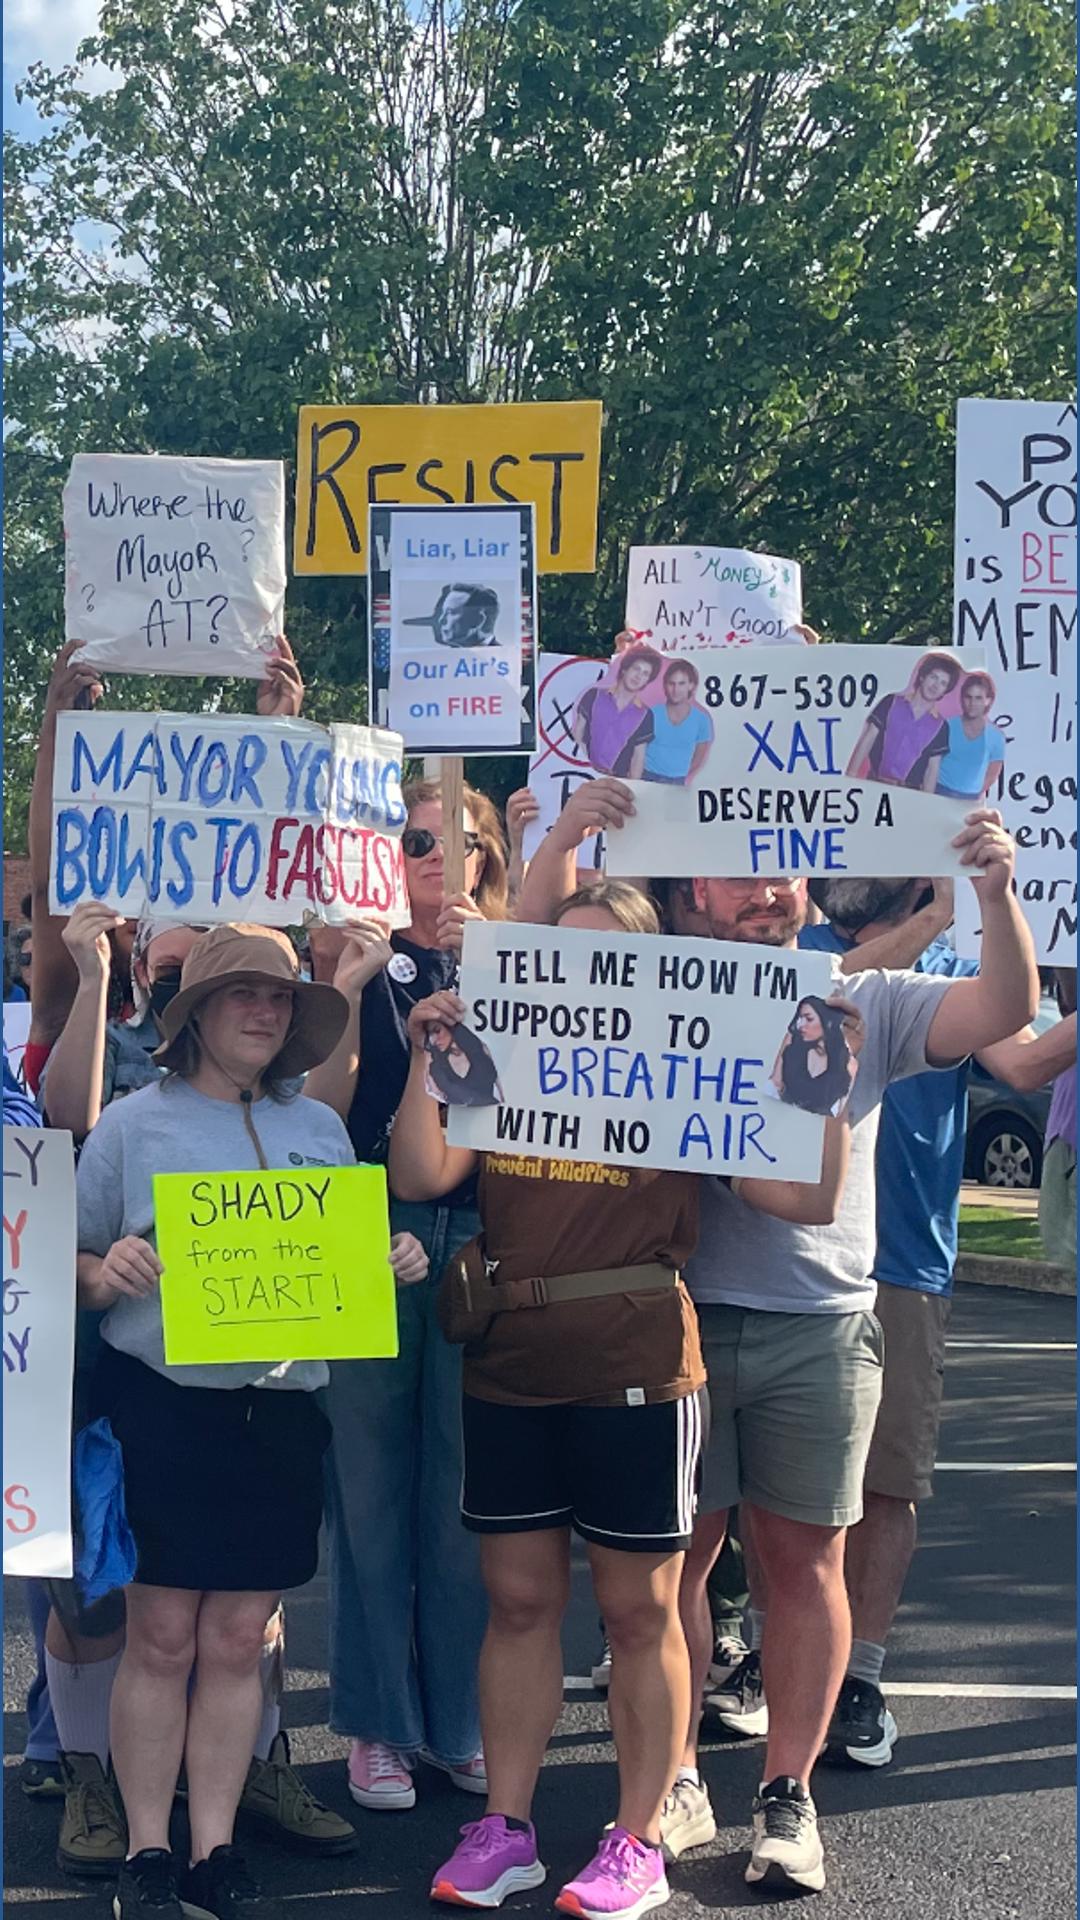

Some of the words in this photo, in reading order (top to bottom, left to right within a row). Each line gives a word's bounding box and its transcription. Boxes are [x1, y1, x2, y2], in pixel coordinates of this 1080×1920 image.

[1023, 433, 1077, 483] P
[197, 485, 254, 523] the
[406, 539, 457, 560] Liar,
[464, 538, 510, 558] Liar
[643, 558, 682, 584] ALL
[964, 538, 1003, 584] is
[1022, 532, 1077, 584] BE
[140, 594, 229, 648] AT?
[655, 599, 718, 627] AIN'T
[730, 606, 789, 640] GOOD
[403, 661, 448, 680] Our
[454, 657, 510, 678] Air's
[704, 673, 878, 710] 867-5309
[409, 702, 440, 718] on
[448, 696, 502, 716] FIRE
[743, 717, 842, 775] XAI
[71, 729, 267, 808] MAYOR
[281, 739, 409, 827] YOUNG
[698, 787, 863, 824] DESERVES
[874, 792, 894, 827] A
[56, 806, 198, 906] BOWS
[205, 817, 262, 907] TO
[265, 816, 411, 911] FASCISM
[749, 828, 847, 874] FINE
[497, 949, 567, 985] TELL
[590, 951, 638, 988] ME
[659, 955, 738, 996] HOW
[753, 960, 798, 1001] I'M
[473, 998, 632, 1042] SUPPOSED
[668, 1014, 711, 1050] TO
[538, 1046, 764, 1106] BREATHE
[496, 1105, 580, 1150] WITH
[603, 1119, 650, 1155] NO
[679, 1112, 777, 1163] AIR
[549, 1160, 630, 1187] Wildfires
[190, 1177, 331, 1227] SHADY
[187, 1240, 256, 1268] from
[273, 1239, 322, 1261] the
